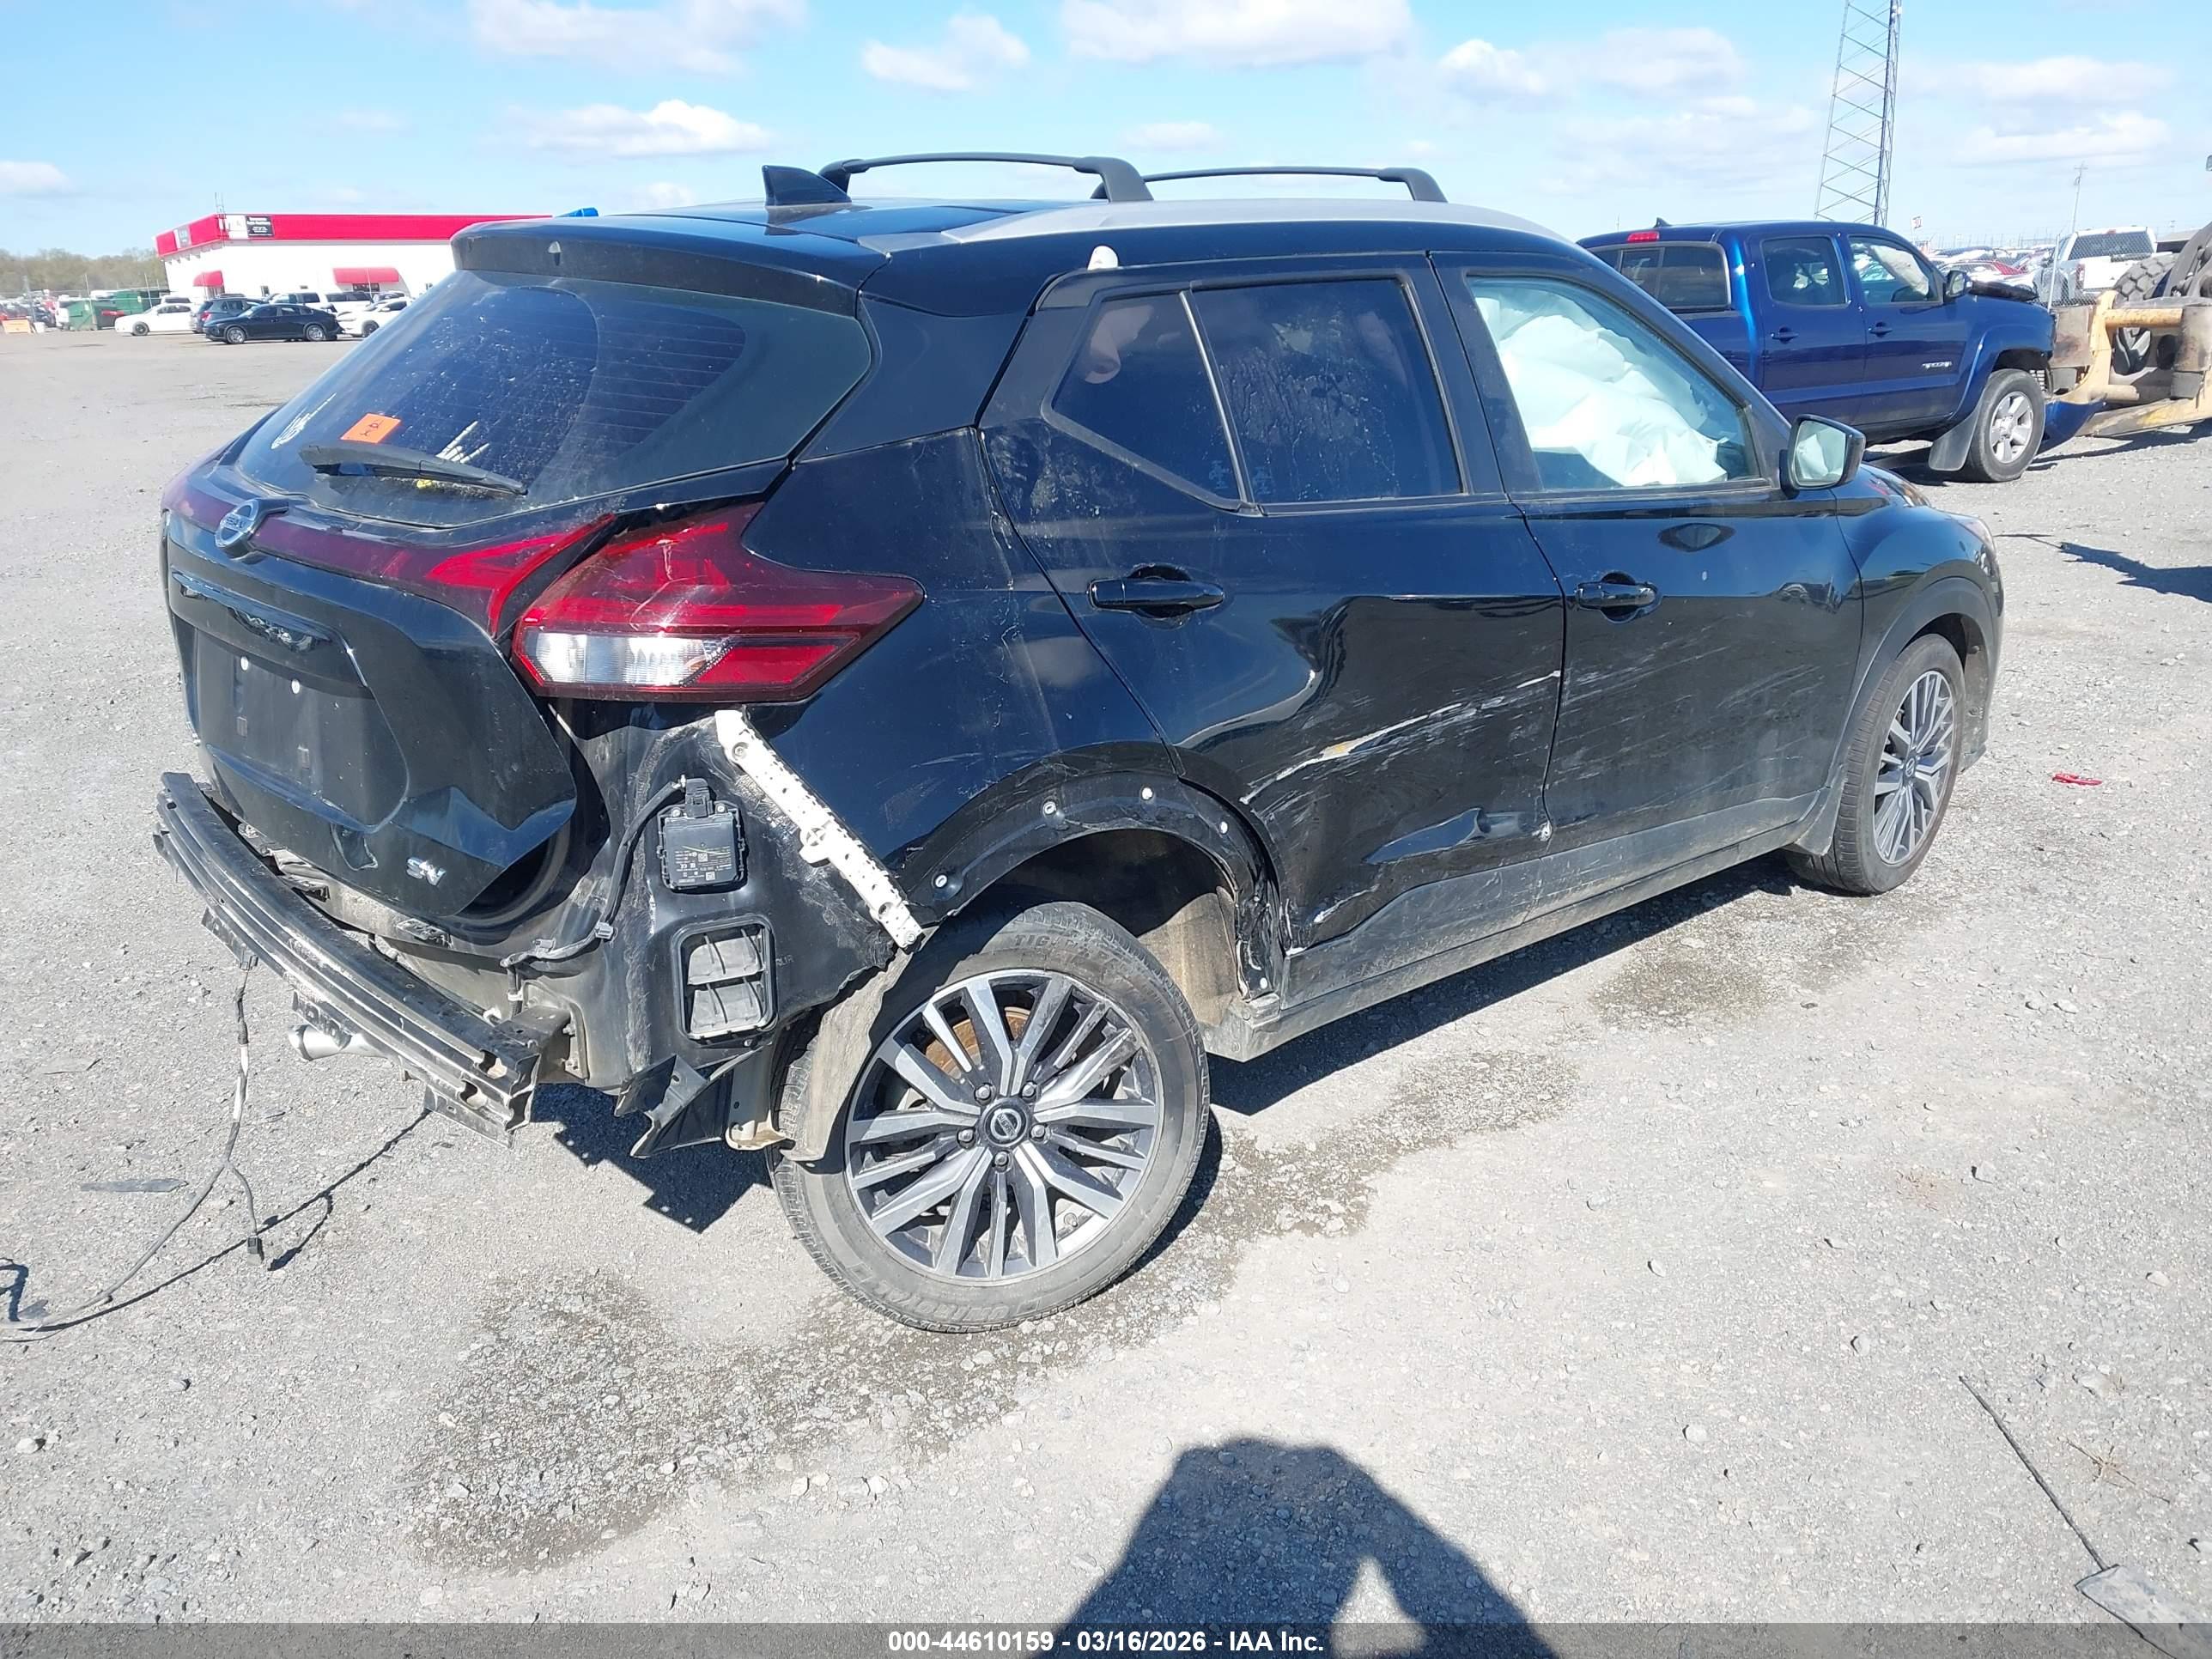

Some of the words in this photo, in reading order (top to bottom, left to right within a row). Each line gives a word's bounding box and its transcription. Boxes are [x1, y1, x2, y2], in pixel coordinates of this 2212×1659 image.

[405, 856, 447, 886] SV
[1014, 933, 1079, 951] TIG
[874, 1277, 1011, 1322] UNIROYAL
